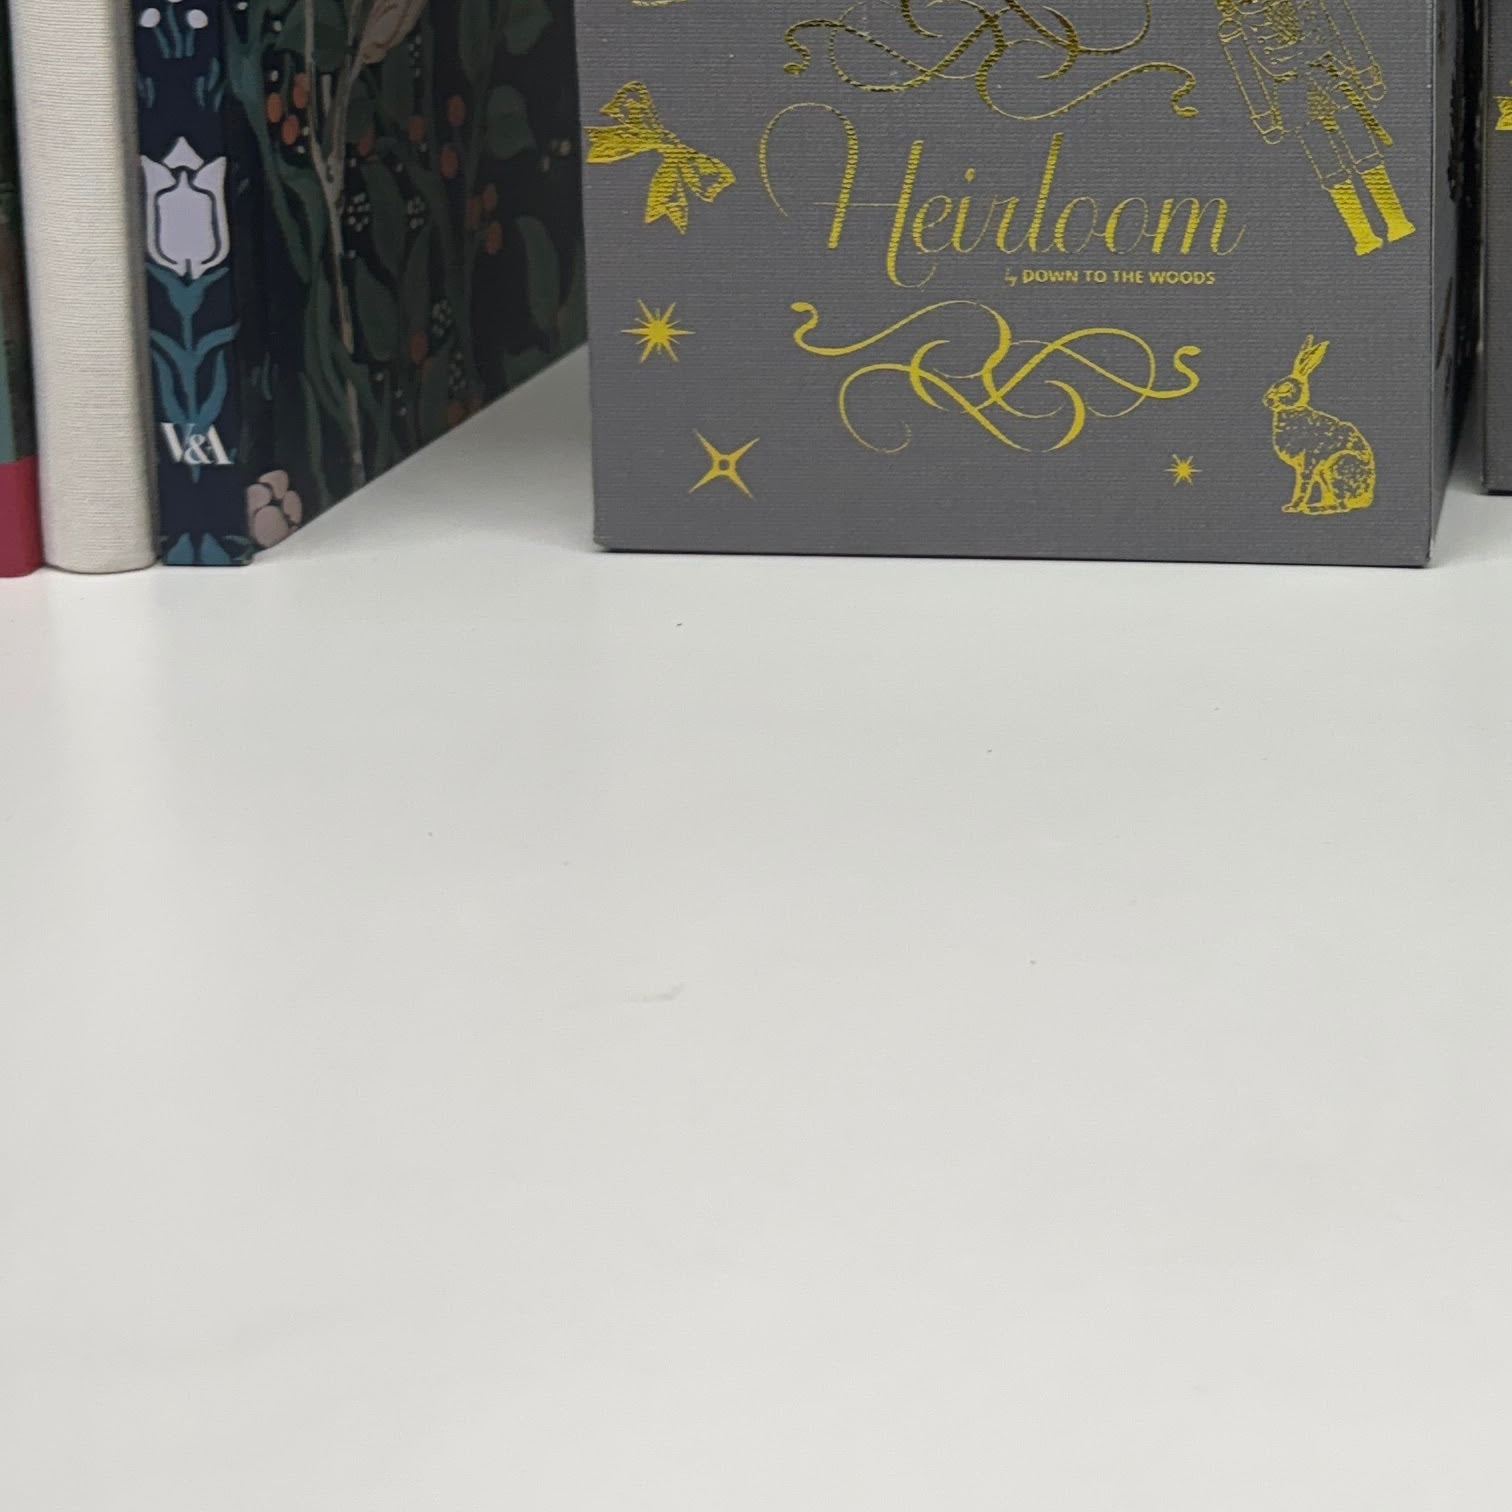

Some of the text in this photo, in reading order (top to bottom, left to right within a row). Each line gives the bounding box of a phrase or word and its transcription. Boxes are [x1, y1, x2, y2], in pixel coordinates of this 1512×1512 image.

[758, 103, 1247, 288] Heirloom
[1022, 269, 1079, 285] DOWN
[1082, 269, 1108, 284] TO
[1112, 270, 1144, 285] THE
[1149, 270, 1217, 286] WOODS
[160, 421, 235, 465] V&A
